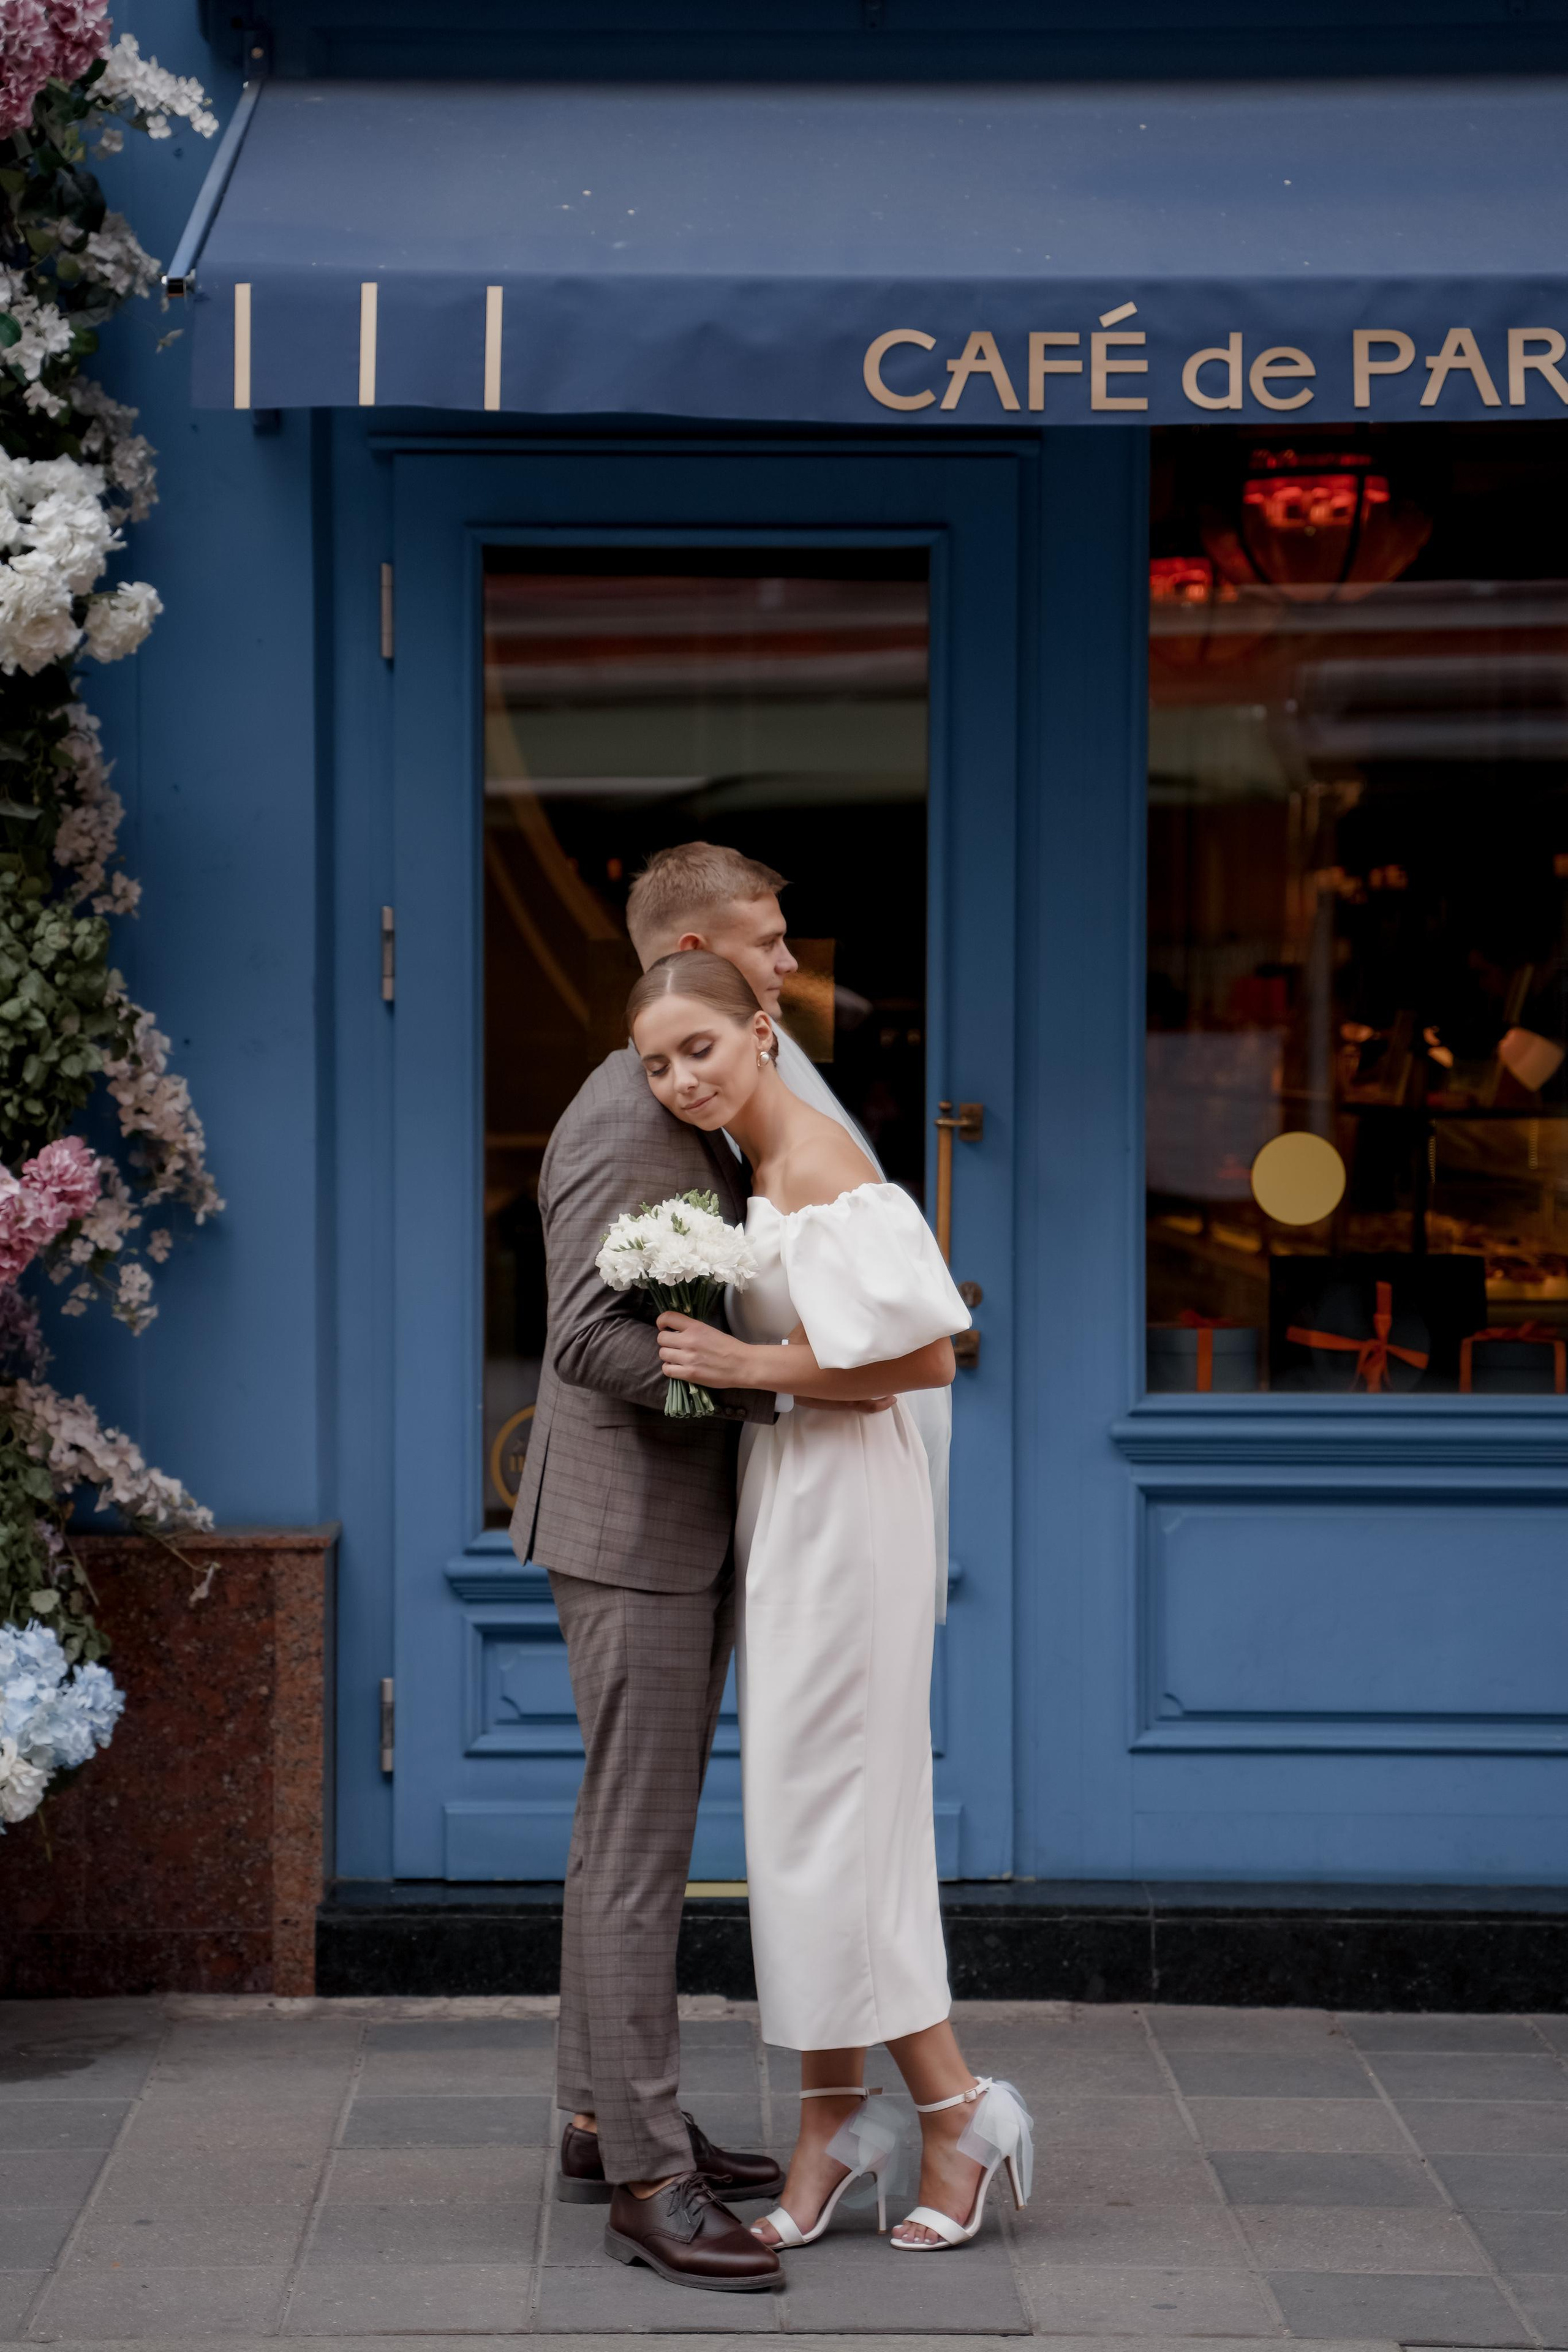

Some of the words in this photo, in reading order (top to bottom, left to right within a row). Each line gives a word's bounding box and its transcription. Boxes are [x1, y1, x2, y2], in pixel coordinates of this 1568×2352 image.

[863, 301, 1149, 412] CAFÉ
[1182, 331, 1317, 411] de
[1352, 327, 1568, 408] PAR
